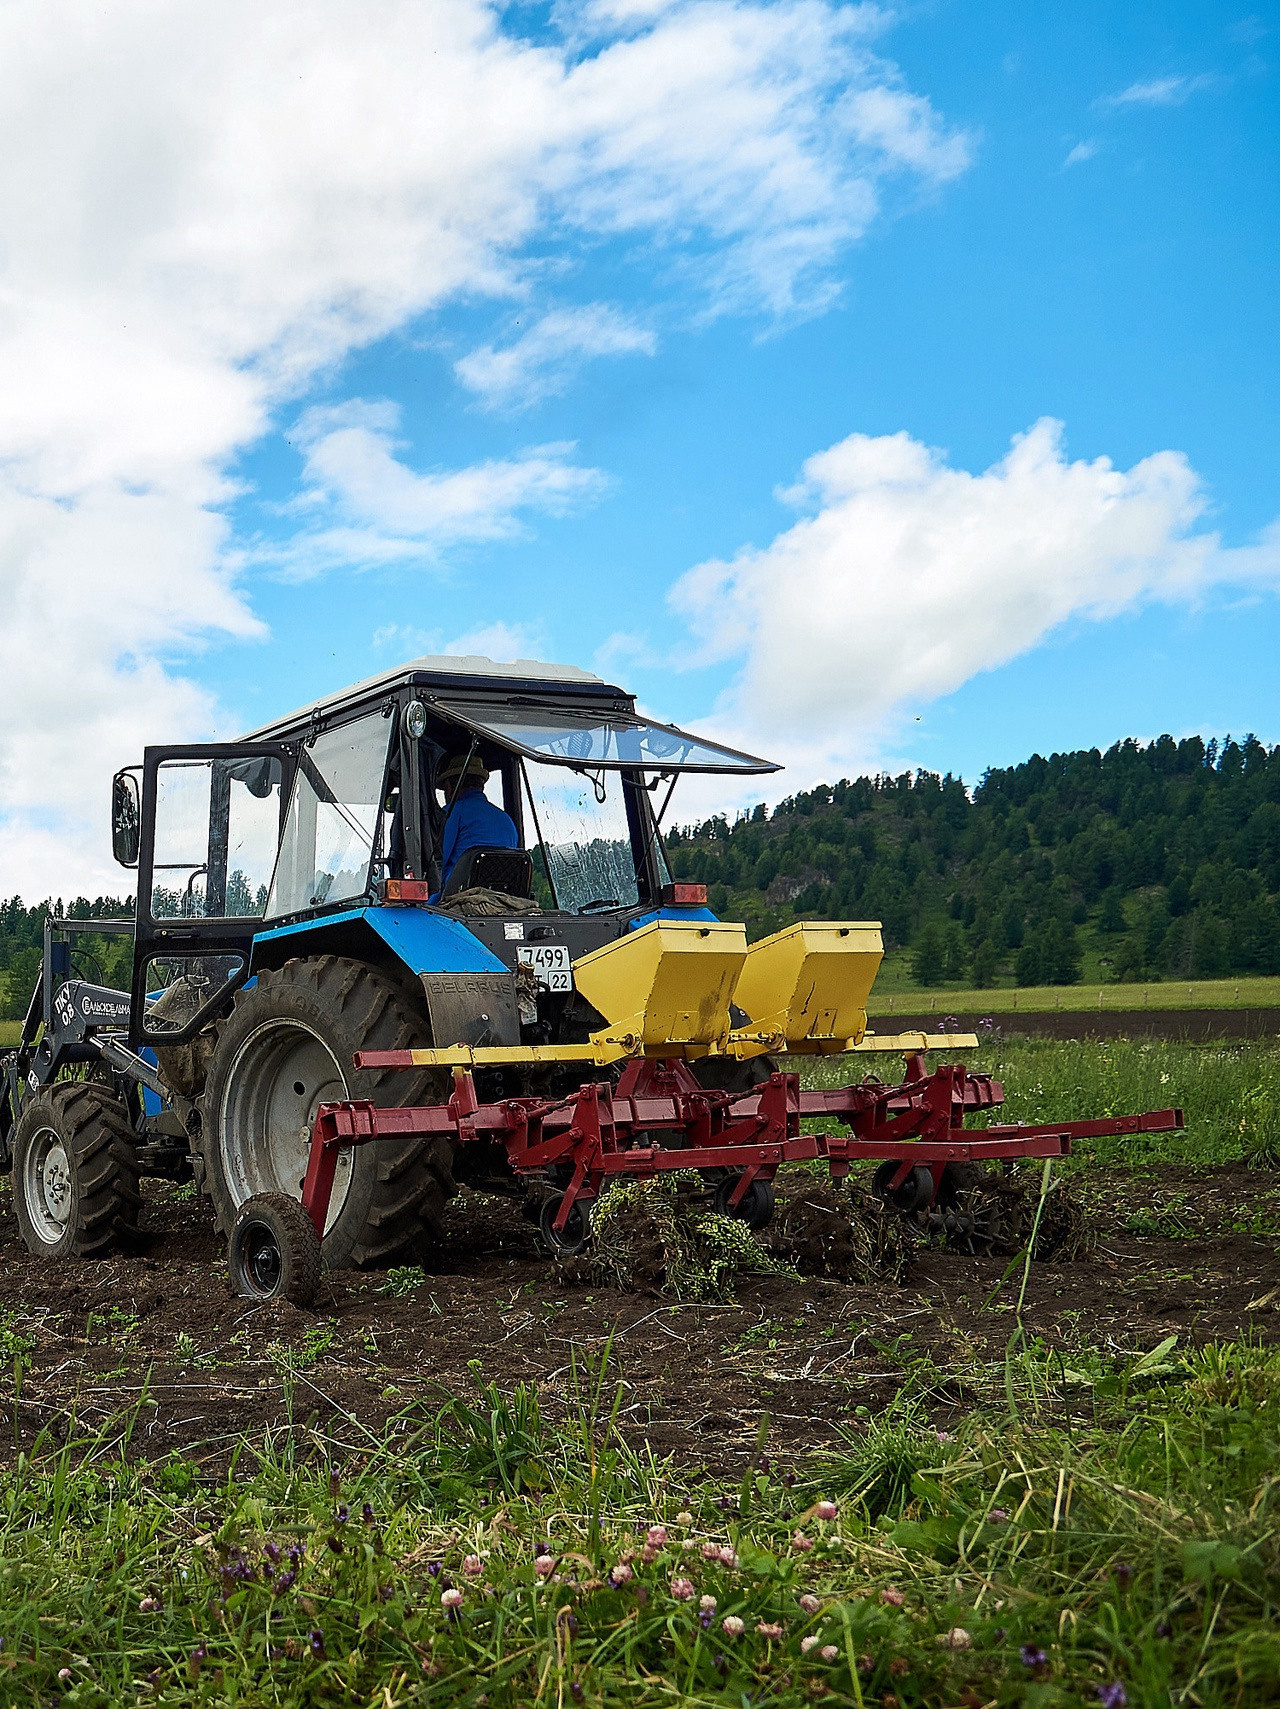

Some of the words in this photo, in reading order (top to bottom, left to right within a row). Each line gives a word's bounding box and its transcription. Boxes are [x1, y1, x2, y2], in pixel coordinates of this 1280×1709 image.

[523, 948, 564, 968] 7499
[430, 981, 512, 994] BELARUS
[552, 973, 568, 989] 22
